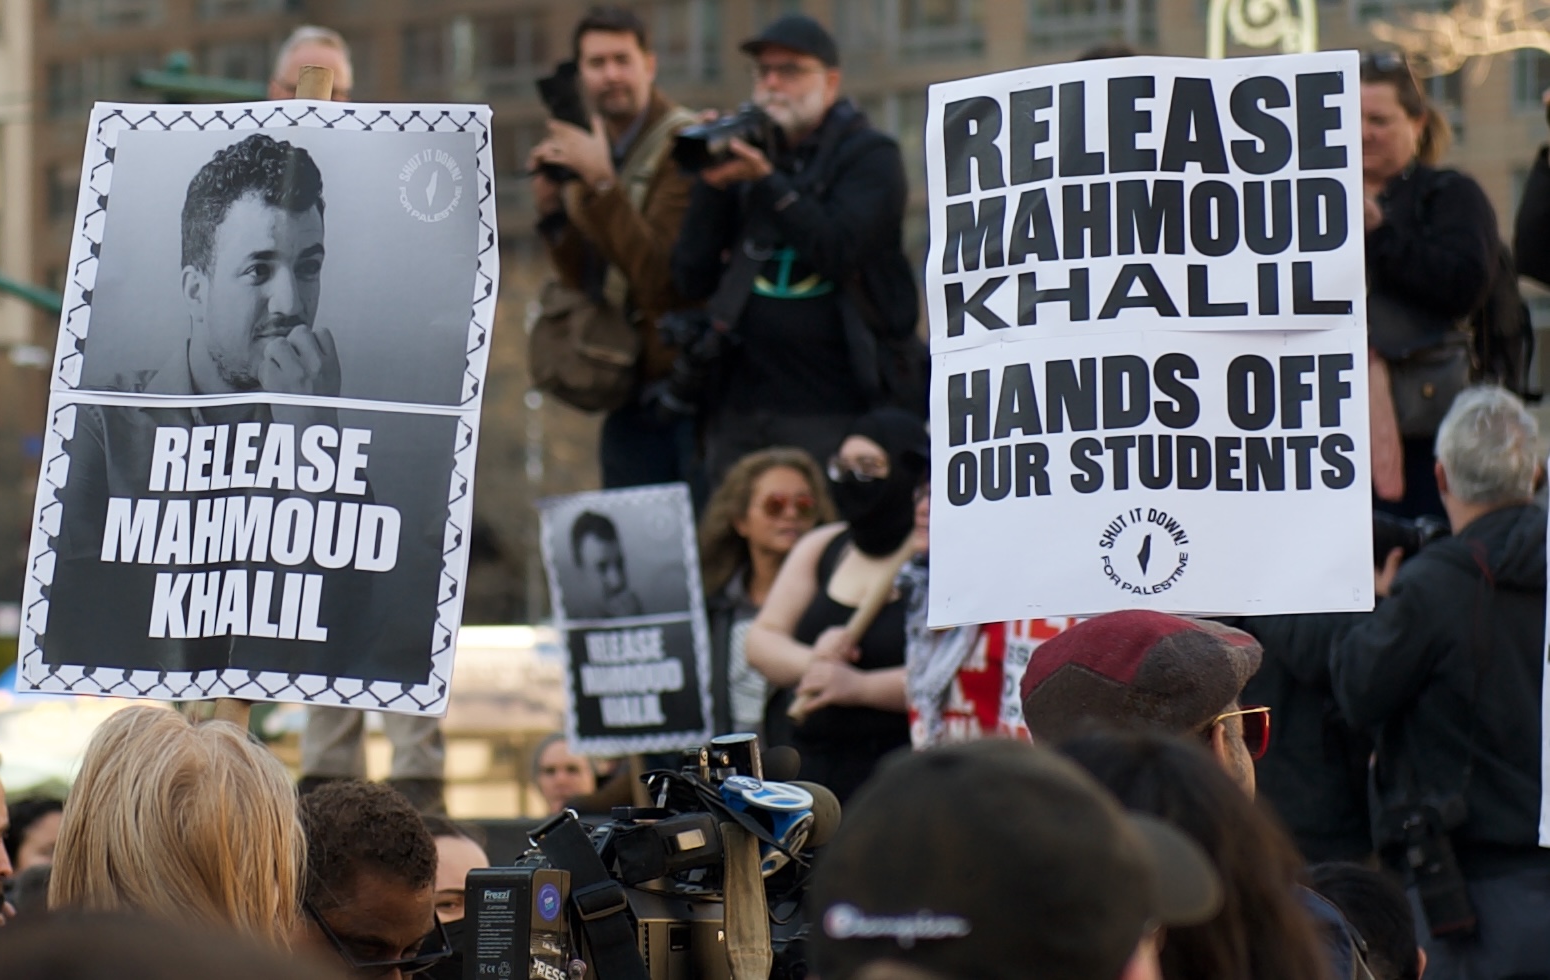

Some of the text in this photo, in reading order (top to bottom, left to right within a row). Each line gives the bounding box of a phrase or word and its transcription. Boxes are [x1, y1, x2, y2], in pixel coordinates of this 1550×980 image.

[398, 149, 463, 182] SHUT IT DOWN!
[942, 71, 1348, 197] RELEASE
[399, 186, 463, 222] FOR PALESTINE
[942, 177, 1349, 274] MAHMOUD
[943, 261, 1353, 338] KHALIL
[948, 353, 1354, 446] HANDS OFF
[149, 422, 372, 495] RELEASE
[947, 433, 1356, 506] OUR STUDENTS
[100, 496, 402, 573] MAHMOUD
[1099, 507, 1190, 549] SHUT IT DOWN!
[149, 569, 329, 642] KHALIL
[1101, 552, 1189, 595] FOR PALESTINE
